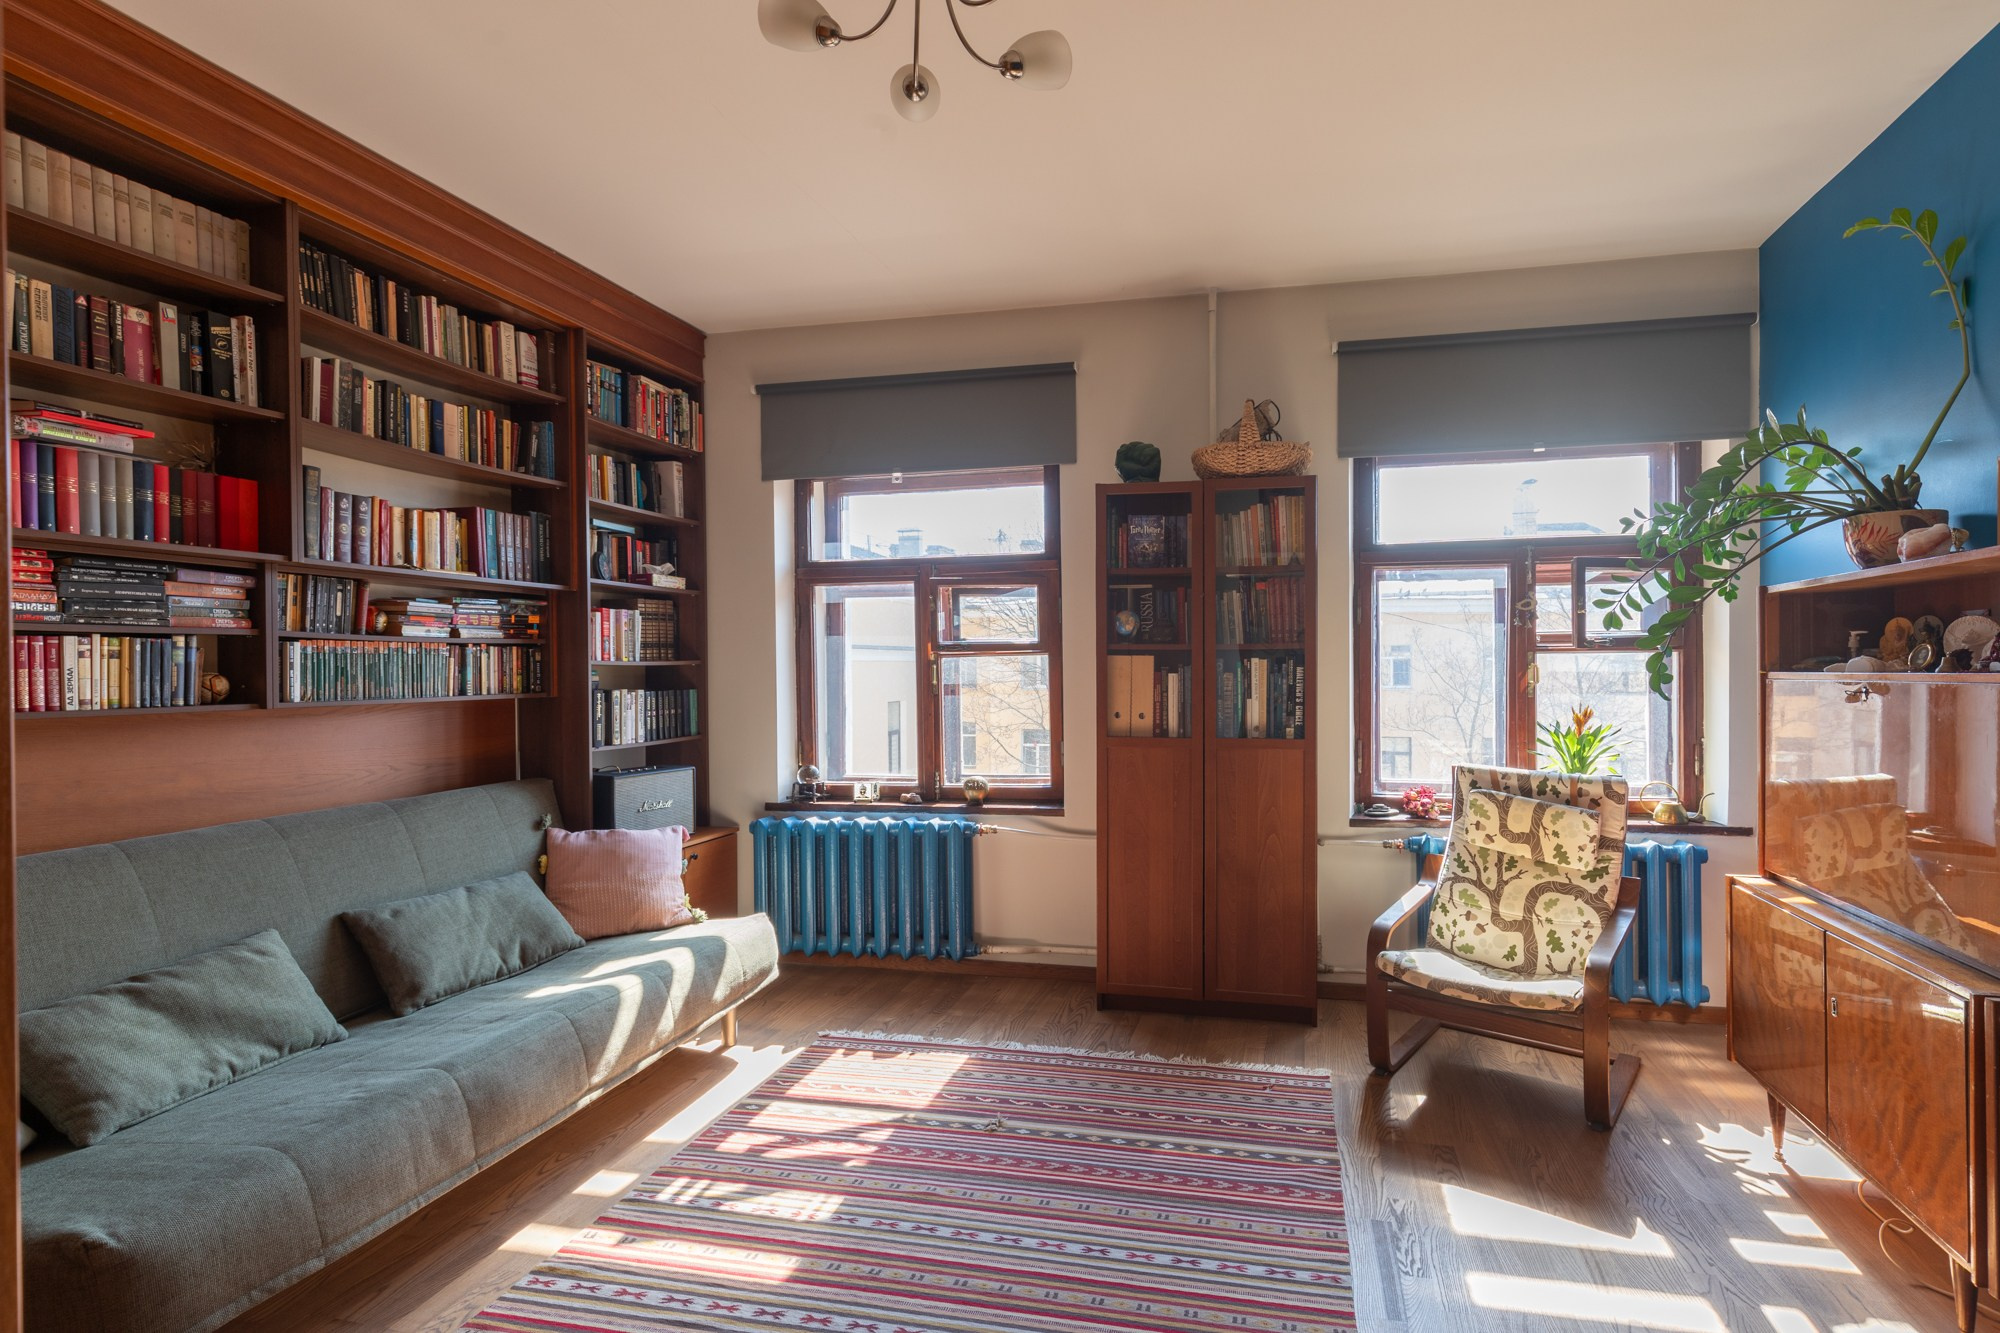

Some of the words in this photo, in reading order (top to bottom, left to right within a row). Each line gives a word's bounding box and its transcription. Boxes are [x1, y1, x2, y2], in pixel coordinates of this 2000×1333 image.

[1140, 592, 1153, 632] RUSSIA
[66, 667, 74, 694] ЗЕРКАЛ
[1296, 666, 1305, 703] MALEVICH'S
[67, 695, 74, 706] АД
[1295, 705, 1303, 726] CIRCLE
[638, 799, 673, 813] Marshall
